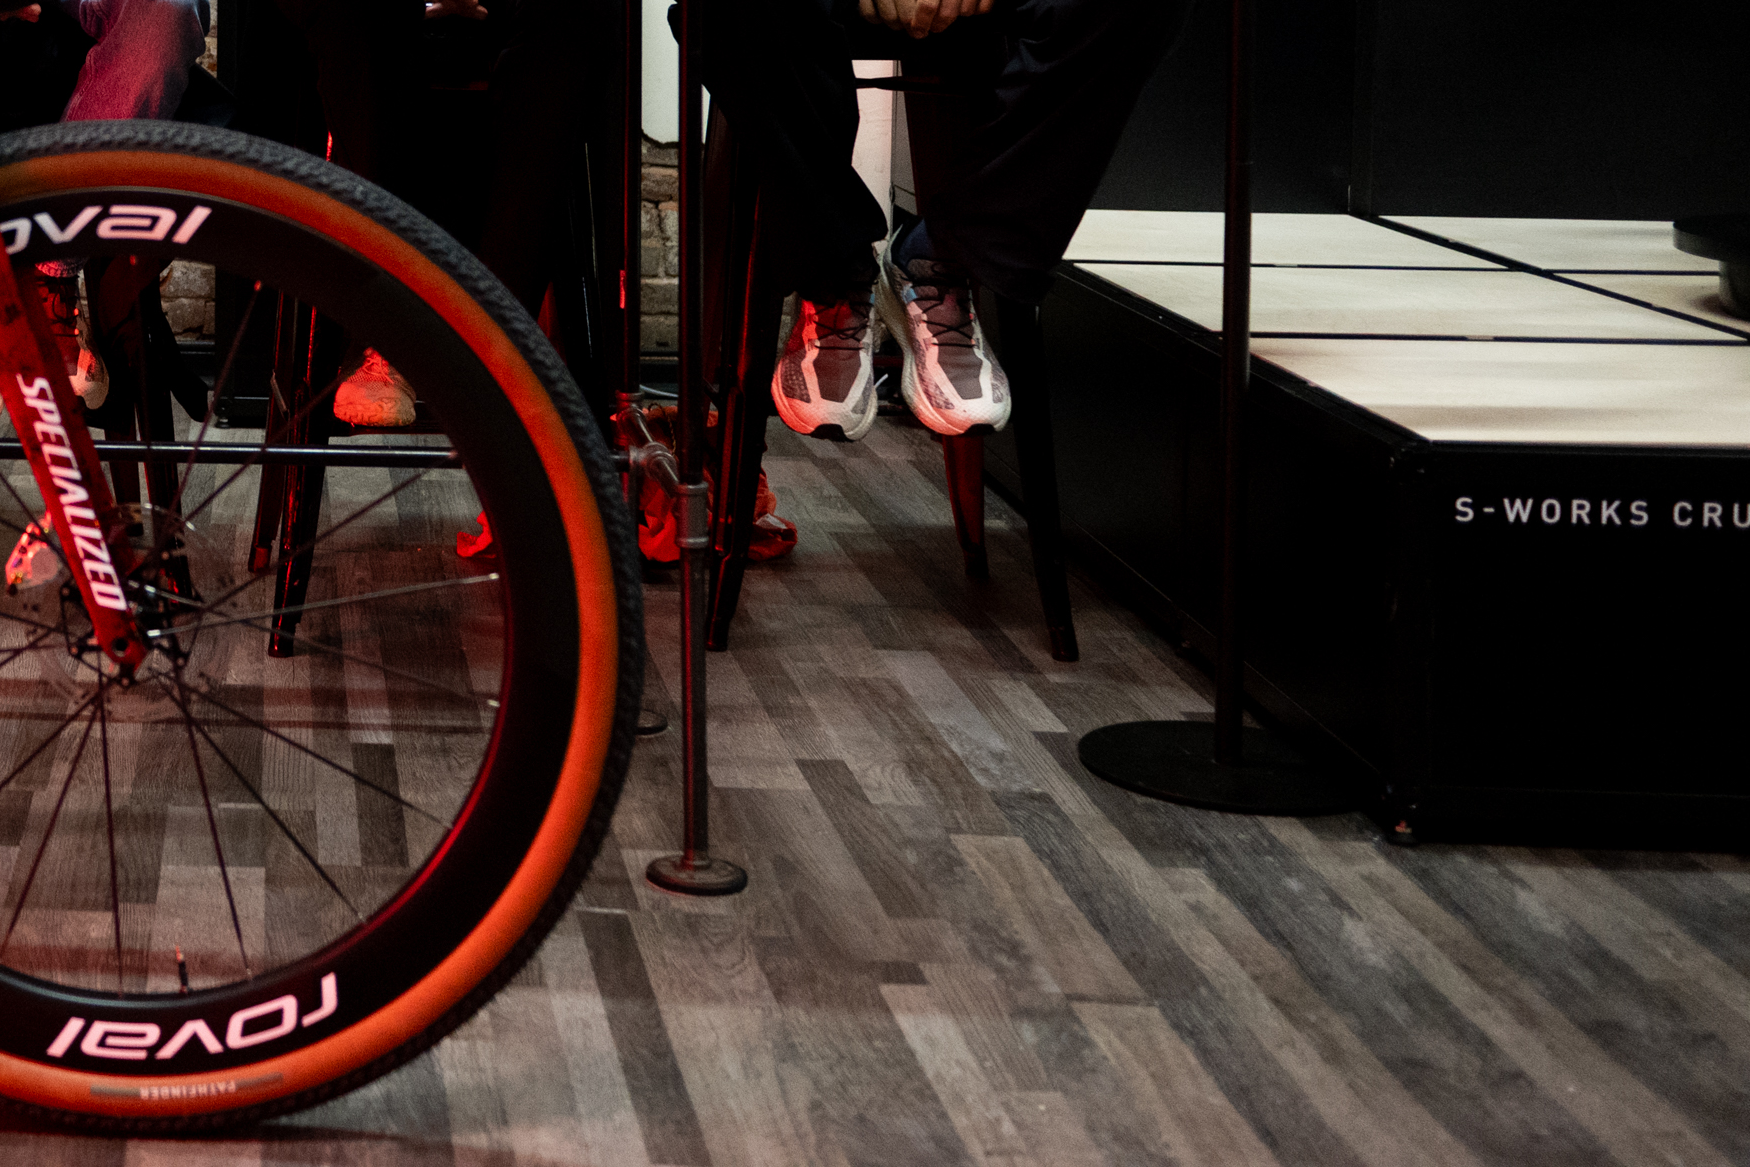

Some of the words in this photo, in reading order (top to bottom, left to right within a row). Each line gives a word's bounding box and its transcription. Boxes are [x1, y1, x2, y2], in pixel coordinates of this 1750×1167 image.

[16, 373, 129, 611] SPECIALIZED
[1454, 496, 1649, 526] S-WORKS
[46, 972, 338, 1060] roval
[140, 1080, 237, 1100] PATHFINDER
